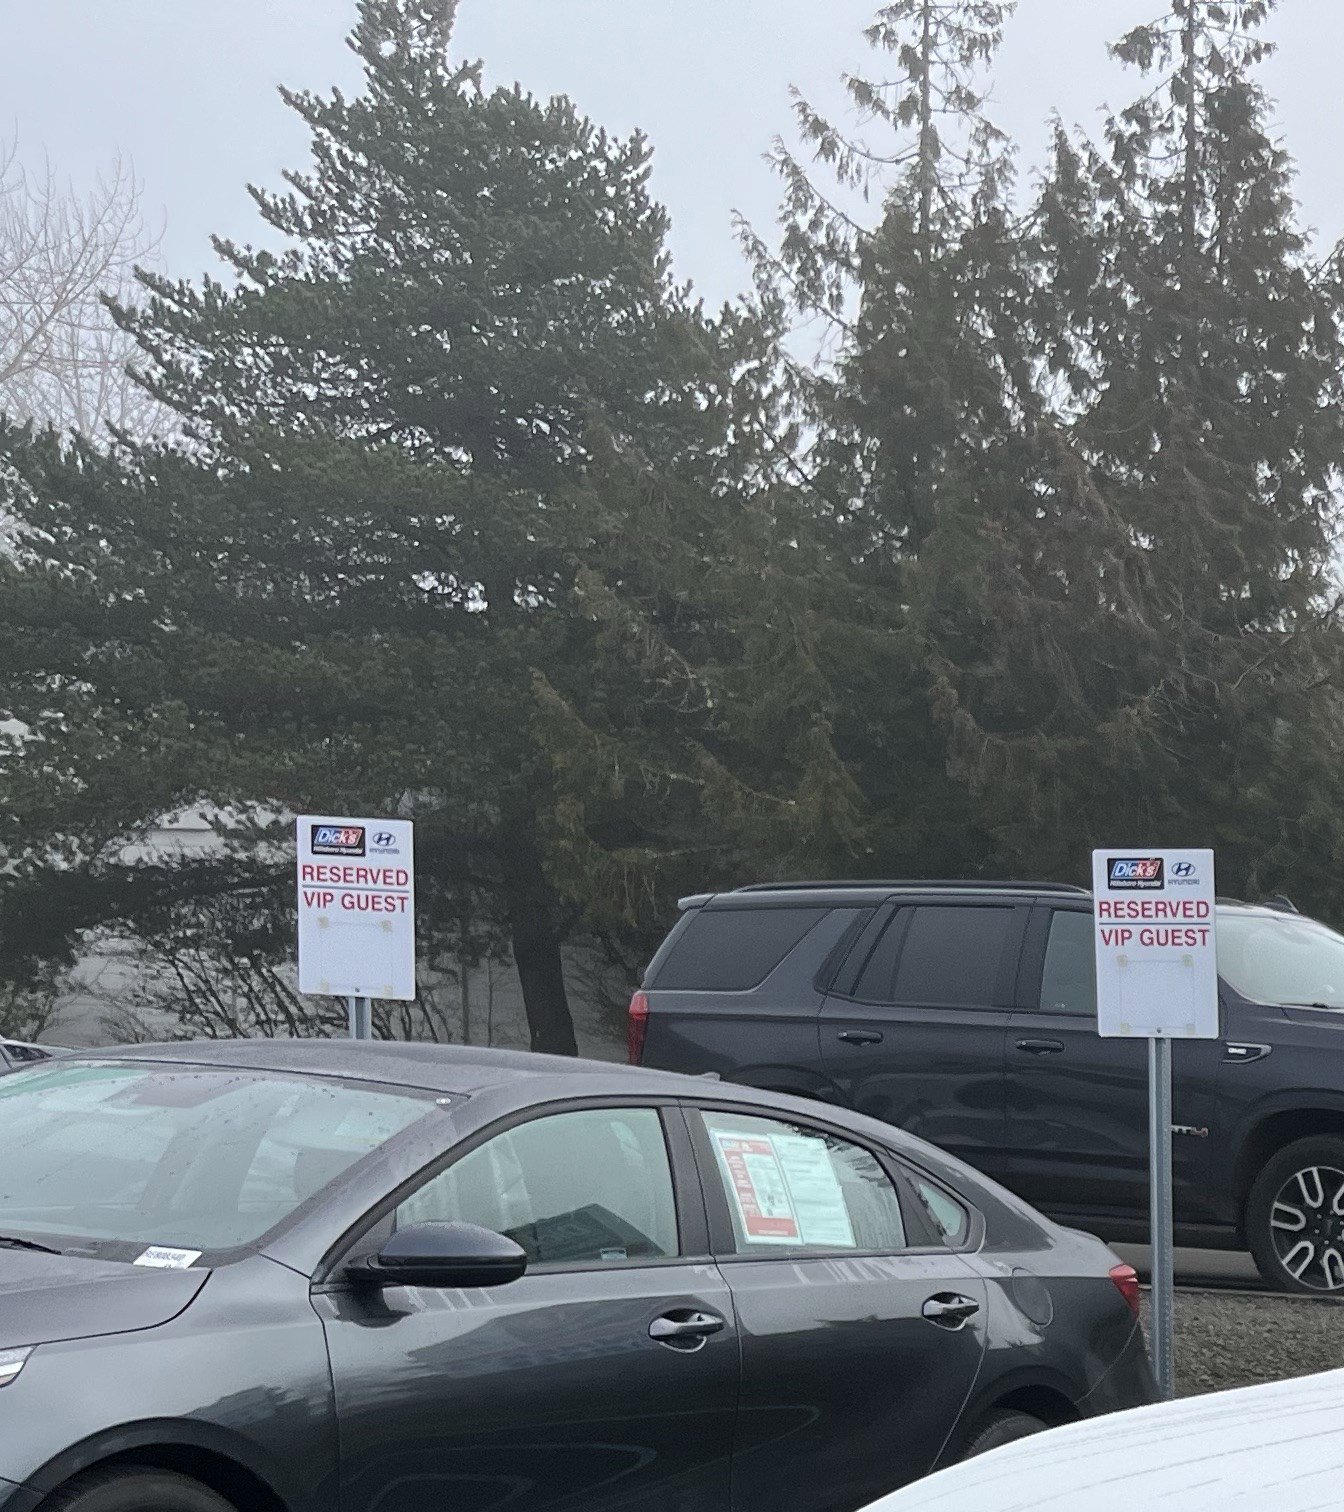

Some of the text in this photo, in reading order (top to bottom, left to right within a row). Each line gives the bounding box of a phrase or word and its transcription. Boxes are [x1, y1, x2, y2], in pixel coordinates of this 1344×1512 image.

[302, 864, 409, 887] RESERVED
[303, 891, 409, 914] VIP GUEST
[1098, 900, 1210, 919] RESERVED
[1100, 928, 1210, 947] VIP GUEST
